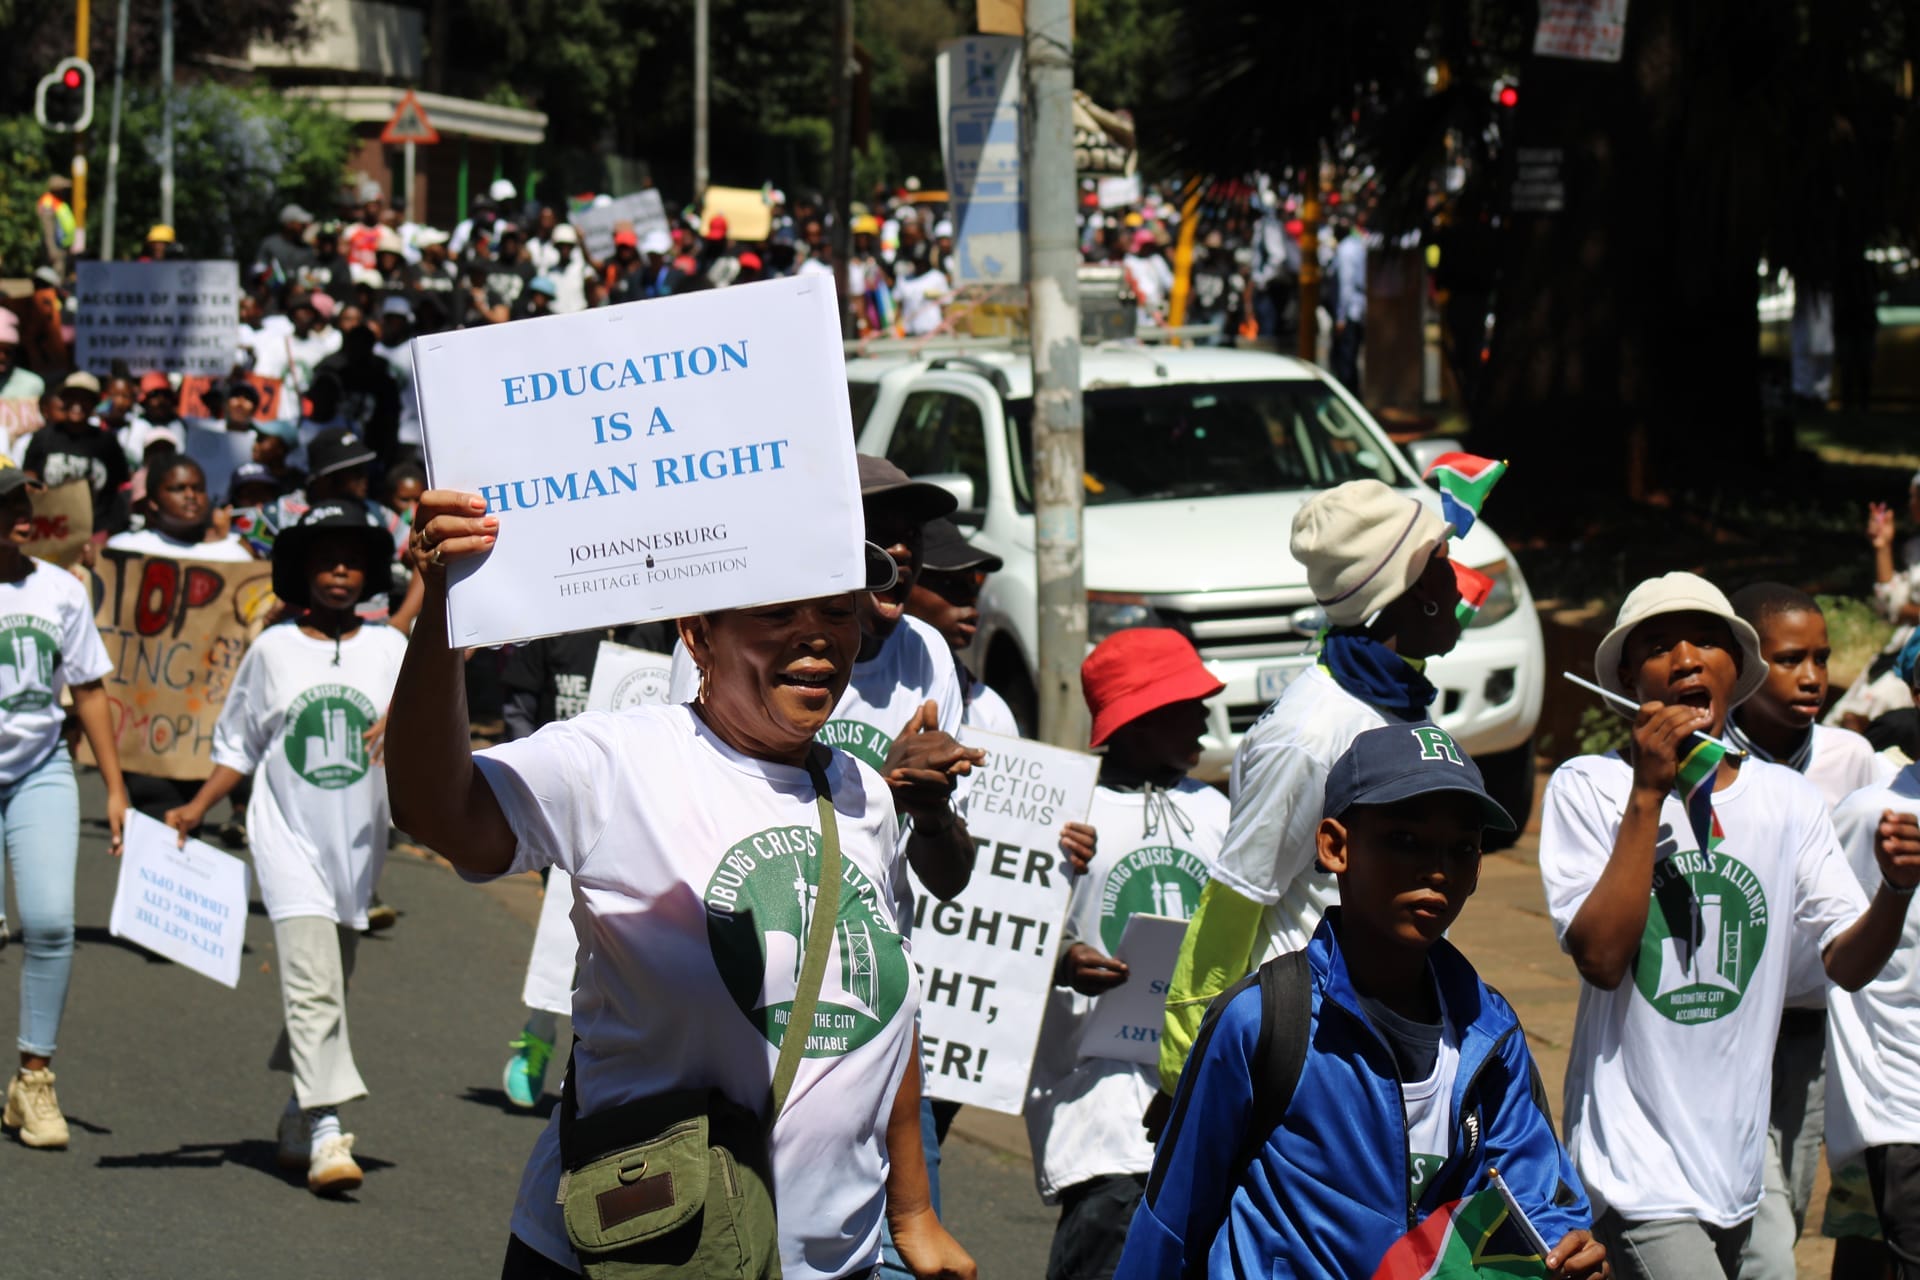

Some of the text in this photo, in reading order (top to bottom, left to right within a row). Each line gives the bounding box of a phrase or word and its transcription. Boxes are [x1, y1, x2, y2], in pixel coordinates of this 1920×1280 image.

[502, 340, 749, 407] EDUCATION
[591, 405, 675, 445] IS A
[479, 440, 789, 515] HUMAN RIGHT
[570, 523, 727, 566] JOHANNESBURG
[560, 557, 748, 597] HERITAGE FOUNDATION
[555, 674, 590, 696] WE
[815, 722, 864, 746] CRISIS
[1411, 726, 1464, 767] R
[970, 790, 1055, 826] TEAMS
[972, 771, 1066, 807] ACTION
[970, 836, 1056, 889] TER
[139, 866, 230, 921] LIBRARY OPEN
[143, 889, 172, 912] CITY
[1101, 863, 1133, 918] JOBURG
[1129, 848, 1174, 871] CRISIS
[1719, 859, 1767, 929] ALLIANCE
[914, 894, 1050, 957] IGHT!
[1708, 991, 1725, 1002] CITY
[814, 1012, 831, 1029] THE
[834, 1014, 856, 1029] CITY
[779, 1033, 849, 1051] AUNTABLE
[922, 1035, 989, 1084] ER!
